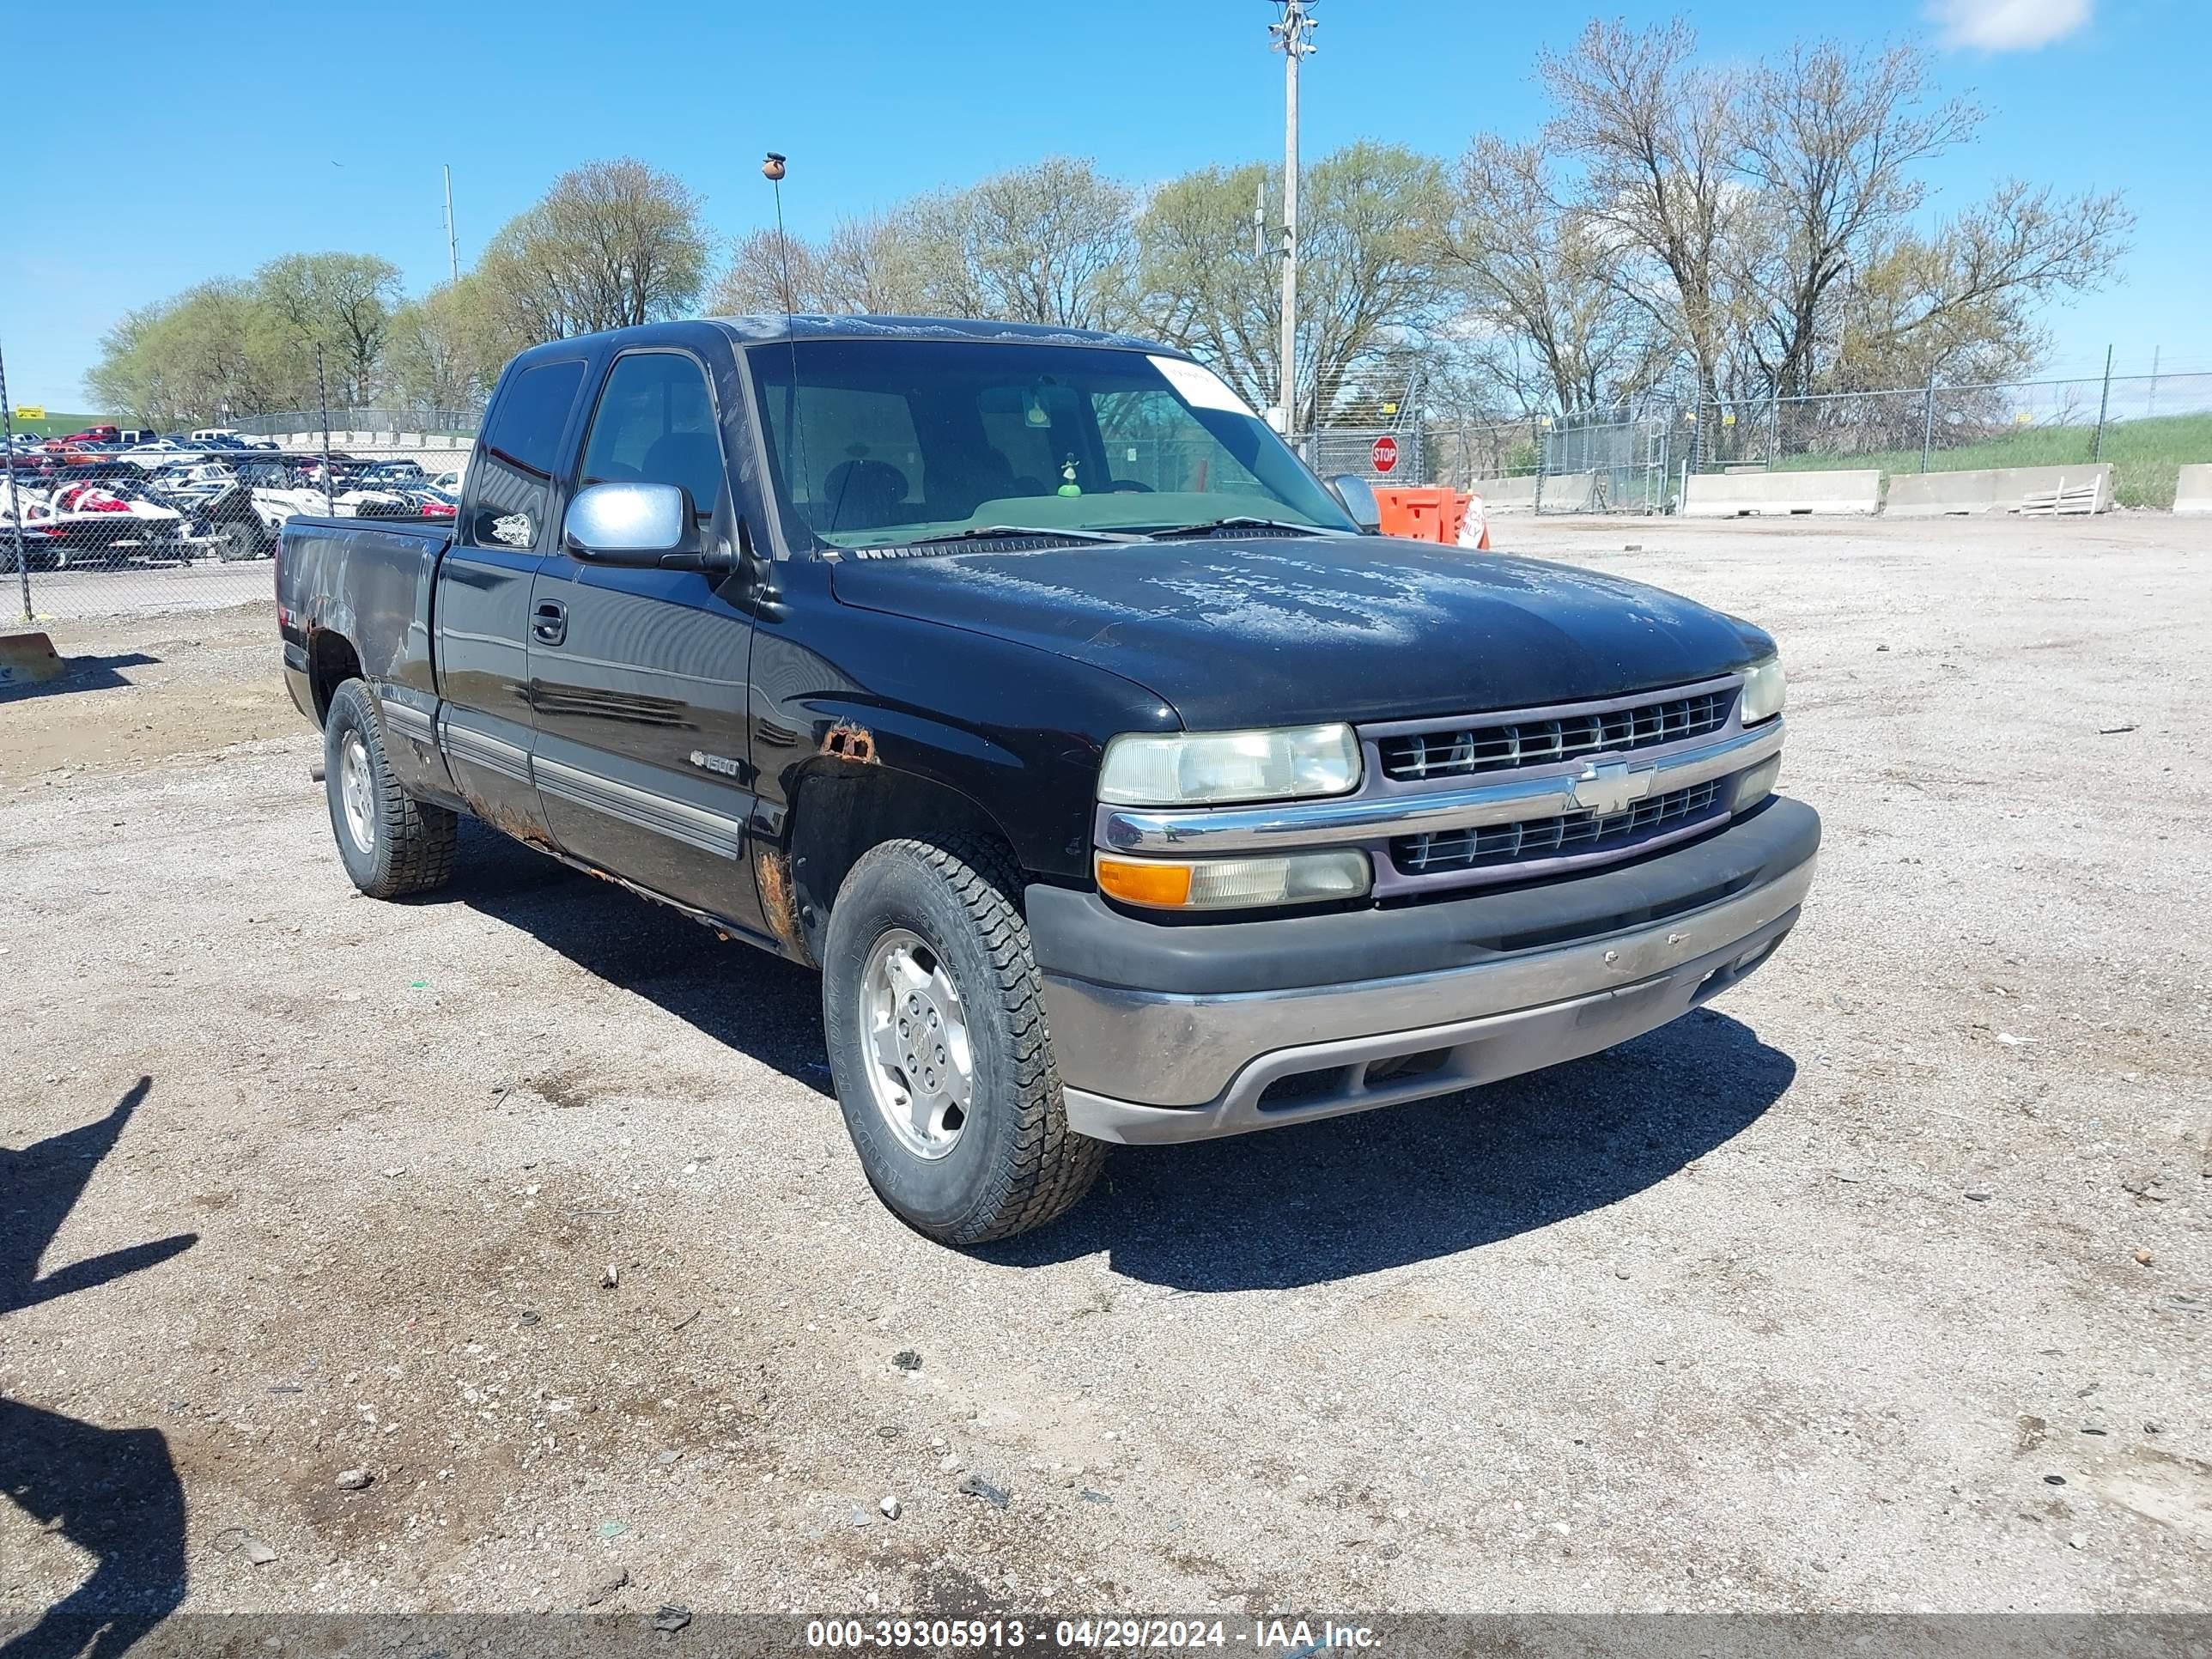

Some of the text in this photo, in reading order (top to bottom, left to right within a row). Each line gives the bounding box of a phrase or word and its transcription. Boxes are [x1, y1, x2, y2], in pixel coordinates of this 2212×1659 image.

[1373, 447, 1396, 463] STOP
[706, 754, 739, 776] 1500
[827, 975, 853, 1092] RADIAL
[850, 1109, 903, 1191] KENDA
